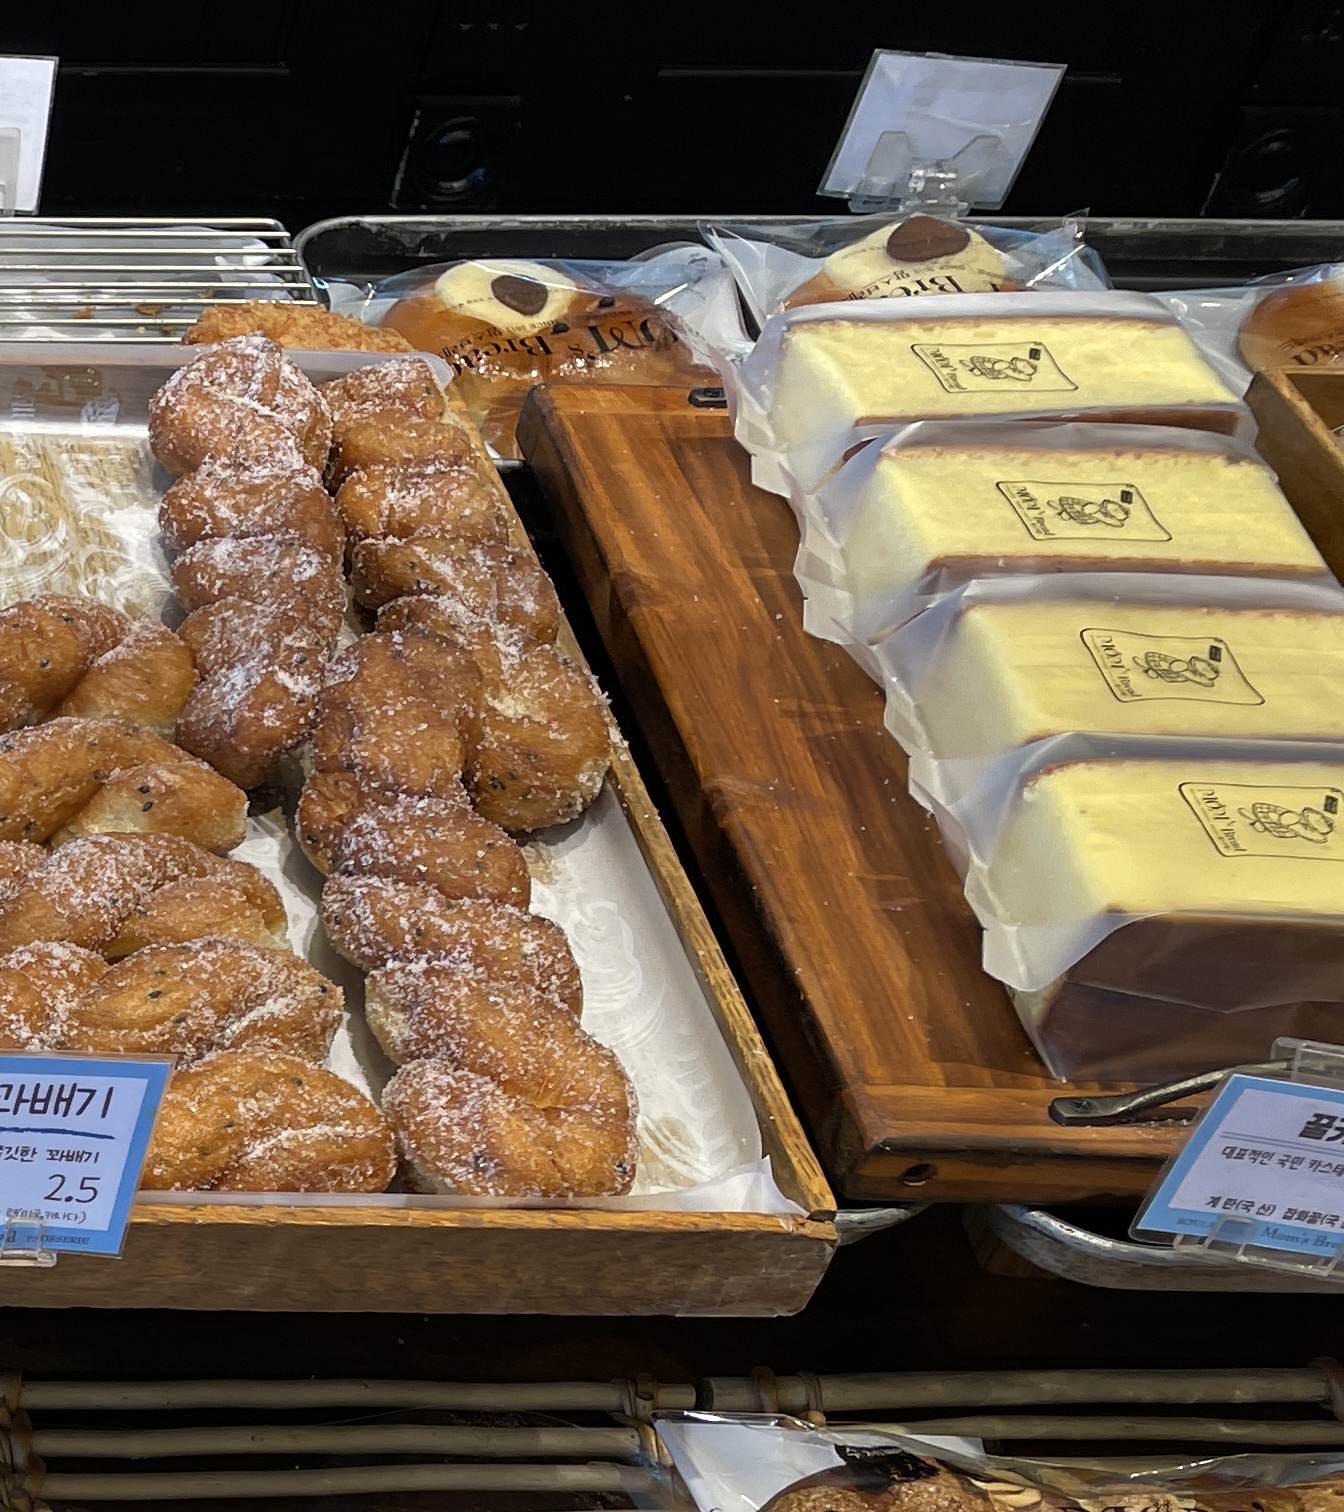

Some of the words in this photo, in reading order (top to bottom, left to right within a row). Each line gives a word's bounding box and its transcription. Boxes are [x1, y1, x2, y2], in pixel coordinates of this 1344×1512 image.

[46, 1149, 98, 1164] 꽈배기
[1277, 1154, 1305, 1170] 국민
[44, 1174, 101, 1204] 2.5
